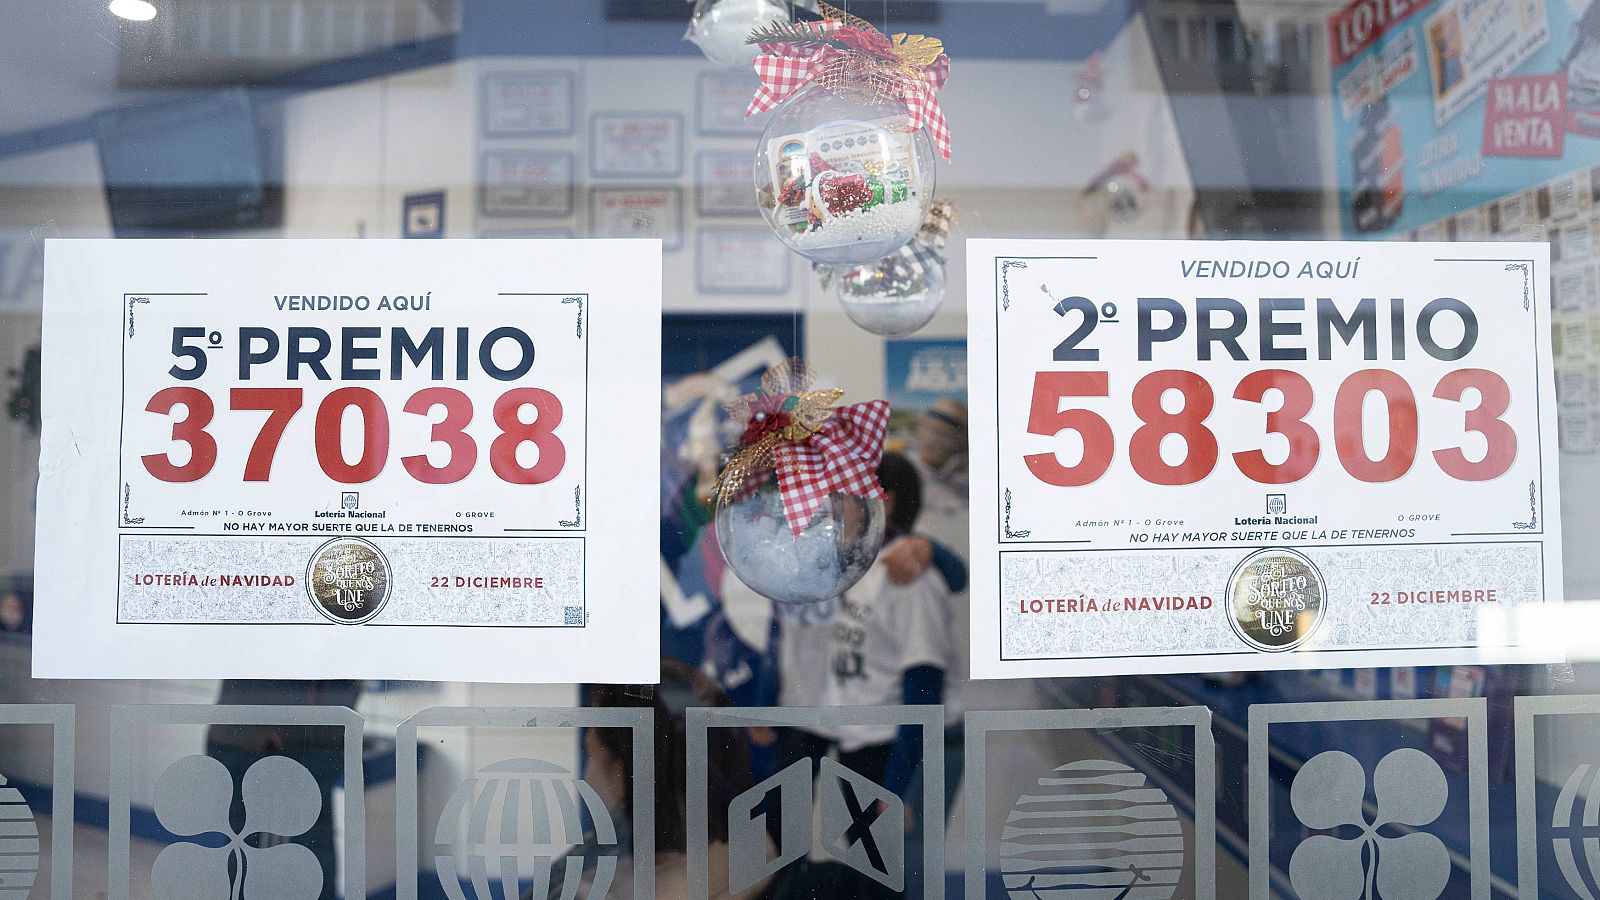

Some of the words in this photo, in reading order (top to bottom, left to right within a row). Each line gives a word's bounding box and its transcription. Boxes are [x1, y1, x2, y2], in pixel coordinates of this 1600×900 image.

[1180, 260, 1290, 279] VENDIDO
[1295, 256, 1360, 279] AQUÍ
[273, 295, 370, 311] VENDIDO
[376, 291, 432, 311] AQUÍ
[1052, 296, 1120, 362] 2º
[1137, 297, 1479, 362] PREMIO
[167, 326, 224, 381] 5º
[238, 326, 536, 382] PREMIO
[140, 386, 567, 485] 37038
[1022, 368, 1519, 488] 58303
[180, 508, 209, 517] Admón
[224, 509, 229, 517] 1
[347, 510, 387, 519] Nacional
[1274, 515, 1319, 526] Nacional
[1397, 514, 1406, 522] O
[1408, 513, 1442, 522] GROVE
[223, 522, 240, 531] NO
[242, 522, 266, 531] HAY
[268, 522, 309, 532] MAYOR
[311, 523, 352, 532] SUERTE
[355, 523, 378, 532] QUE
[380, 523, 395, 532] LA
[398, 523, 413, 532] DE
[415, 523, 474, 533] TENERNOS
[1074, 518, 1110, 528] Admón
[1127, 519, 1133, 527] 1
[1144, 518, 1152, 527] O
[1155, 518, 1186, 527] Grove
[1129, 533, 1149, 543] NO
[1152, 532, 1180, 543] HAY
[1181, 532, 1228, 542] MAYOR
[1230, 531, 1279, 541] SUERTE
[1281, 530, 1309, 541] QUE
[1311, 530, 1327, 540] LA
[1330, 529, 1348, 540] DE
[1351, 528, 1416, 539] TENERNOS
[134, 571, 199, 586] LOTERÍA
[201, 575, 217, 587] de
[220, 575, 295, 587] NAVIDAD
[431, 576, 449, 588] 22
[455, 576, 544, 589] DICIEMBRE
[332, 589, 365, 612] UNE
[1020, 594, 1099, 614] LOTERÍA
[1102, 598, 1121, 612] de
[1124, 596, 1213, 611] NAVIDAD
[1370, 592, 1390, 605] 22
[1397, 589, 1497, 605] DICIEMBRE
[1255, 609, 1295, 637] UNE
[750, 784, 782, 864] 1
[835, 773, 890, 876] X
